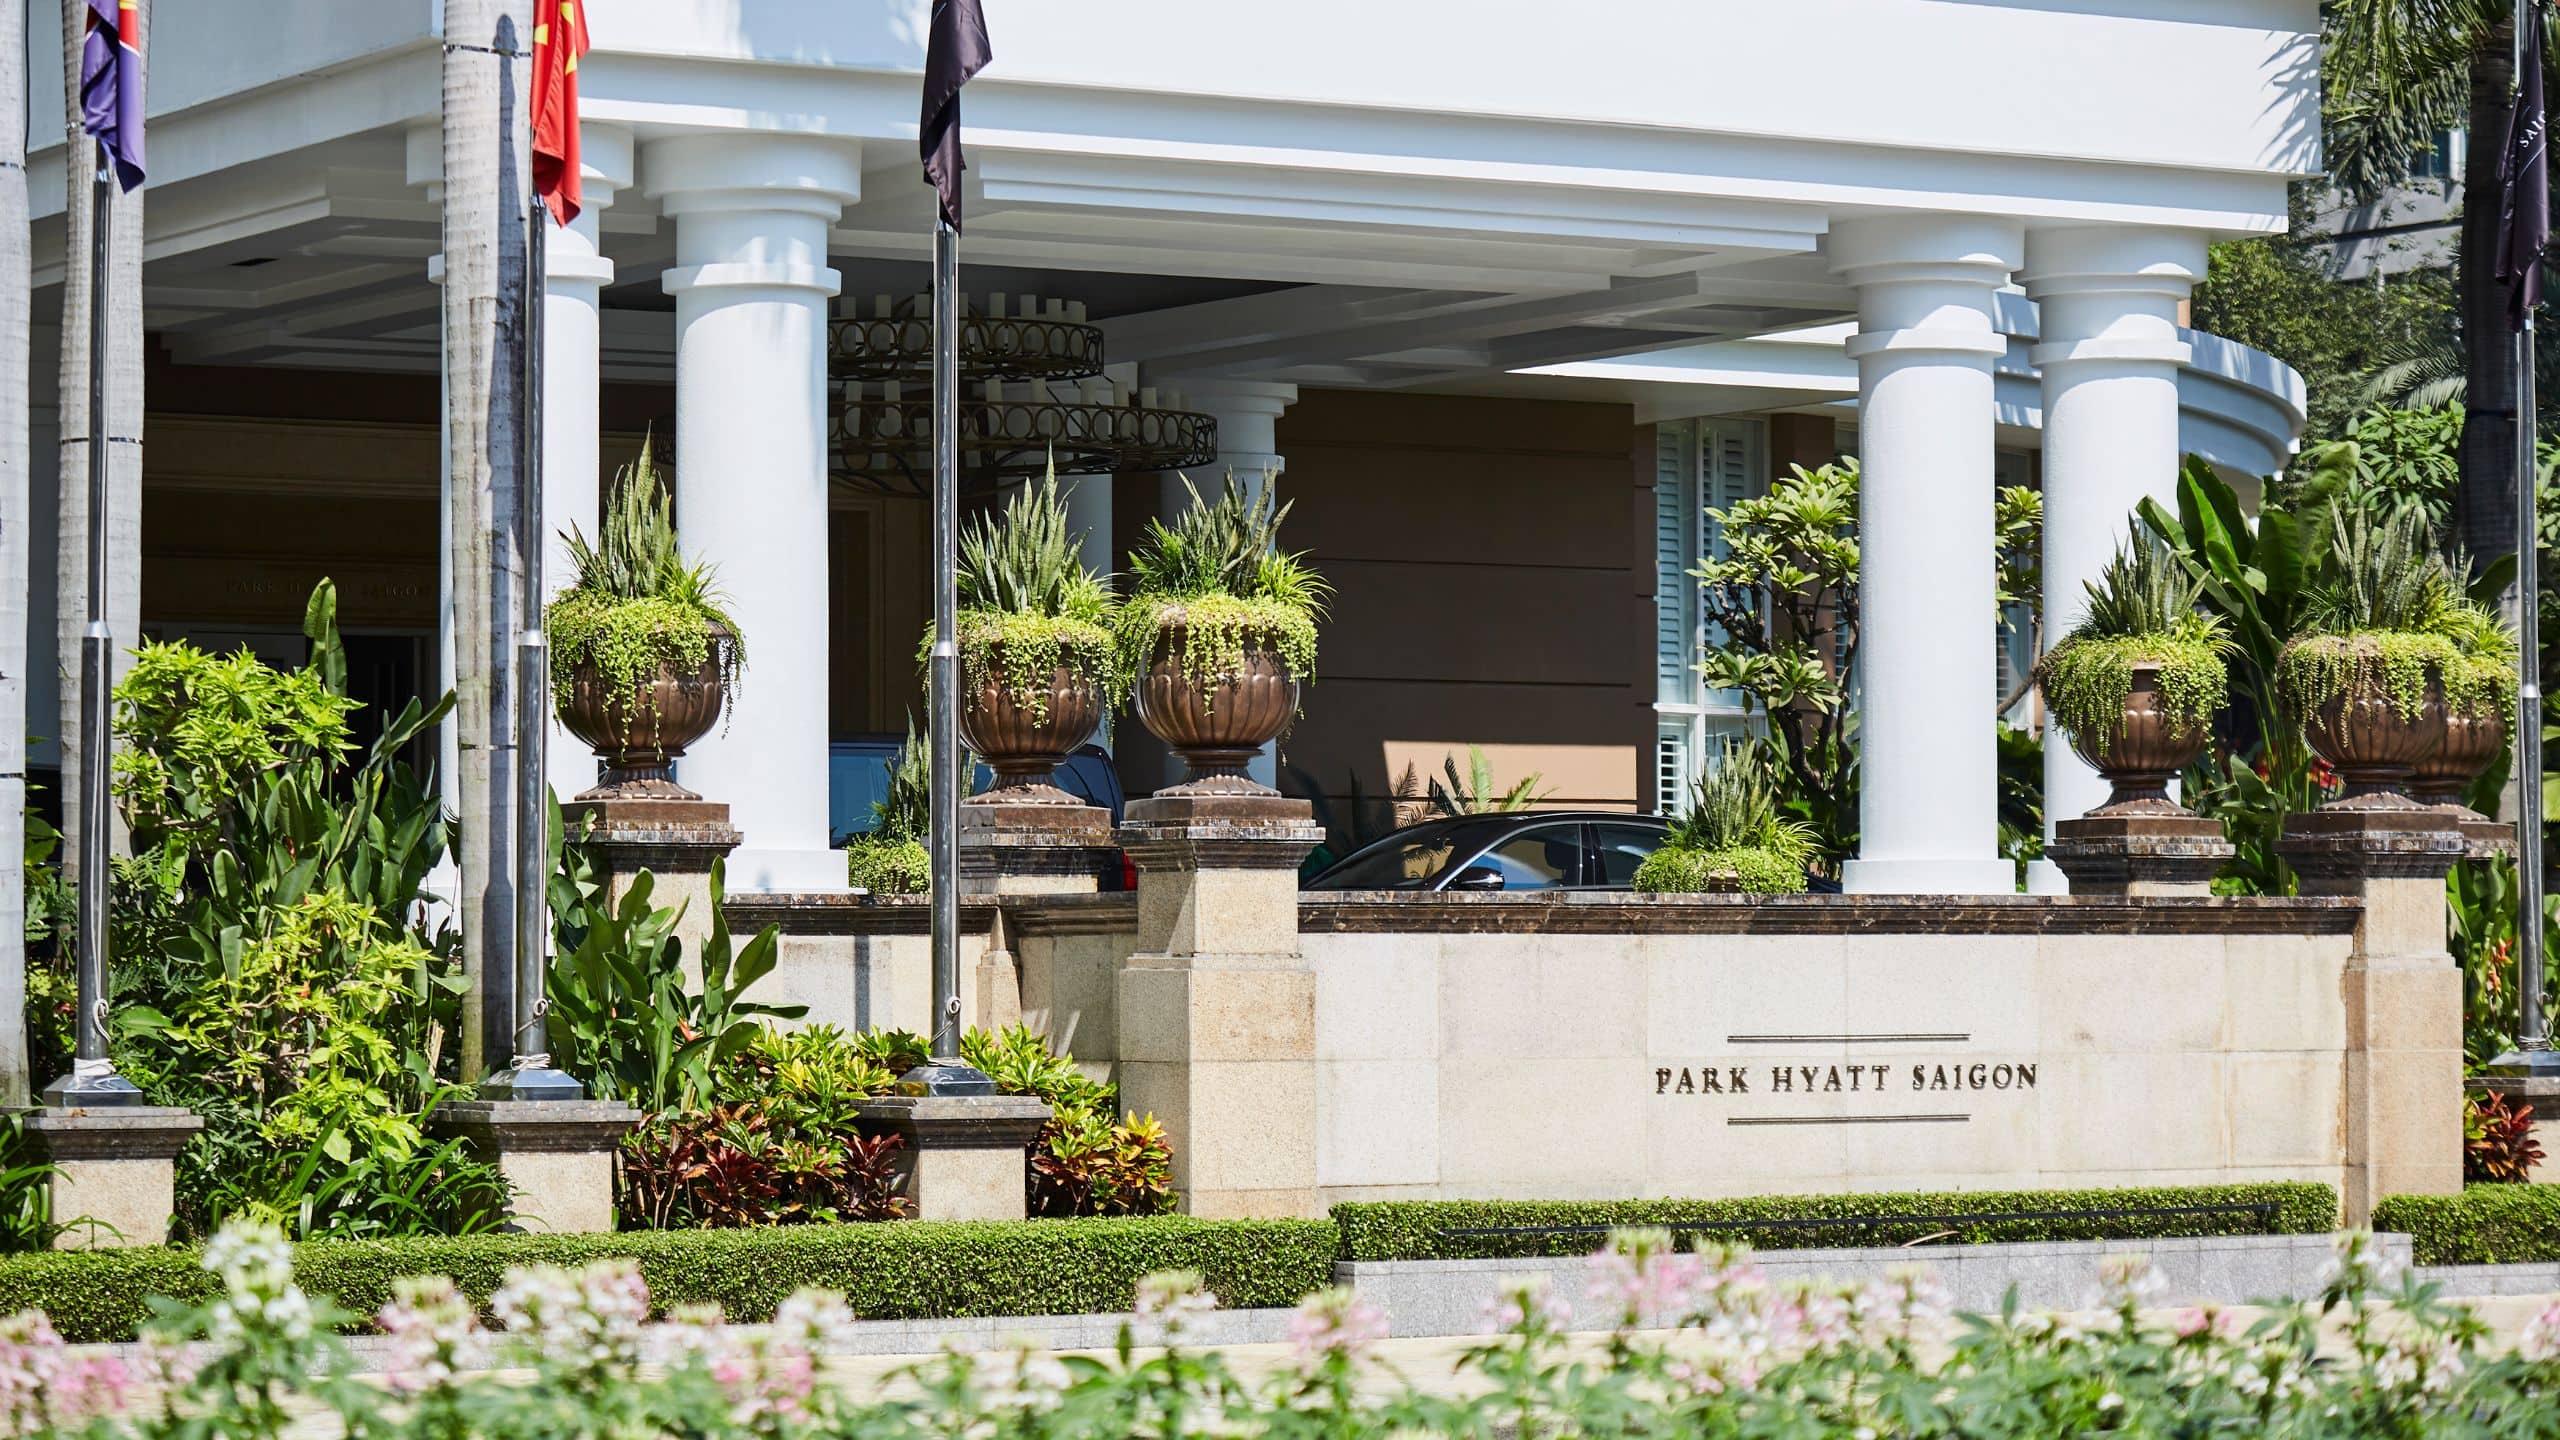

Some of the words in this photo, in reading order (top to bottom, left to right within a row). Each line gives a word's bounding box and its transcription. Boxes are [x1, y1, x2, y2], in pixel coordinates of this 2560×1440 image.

[1656, 1067, 1749, 1095] PARK
[1772, 1065, 1891, 1093] HYATT
[1912, 1063, 2038, 1092] SAIGON
